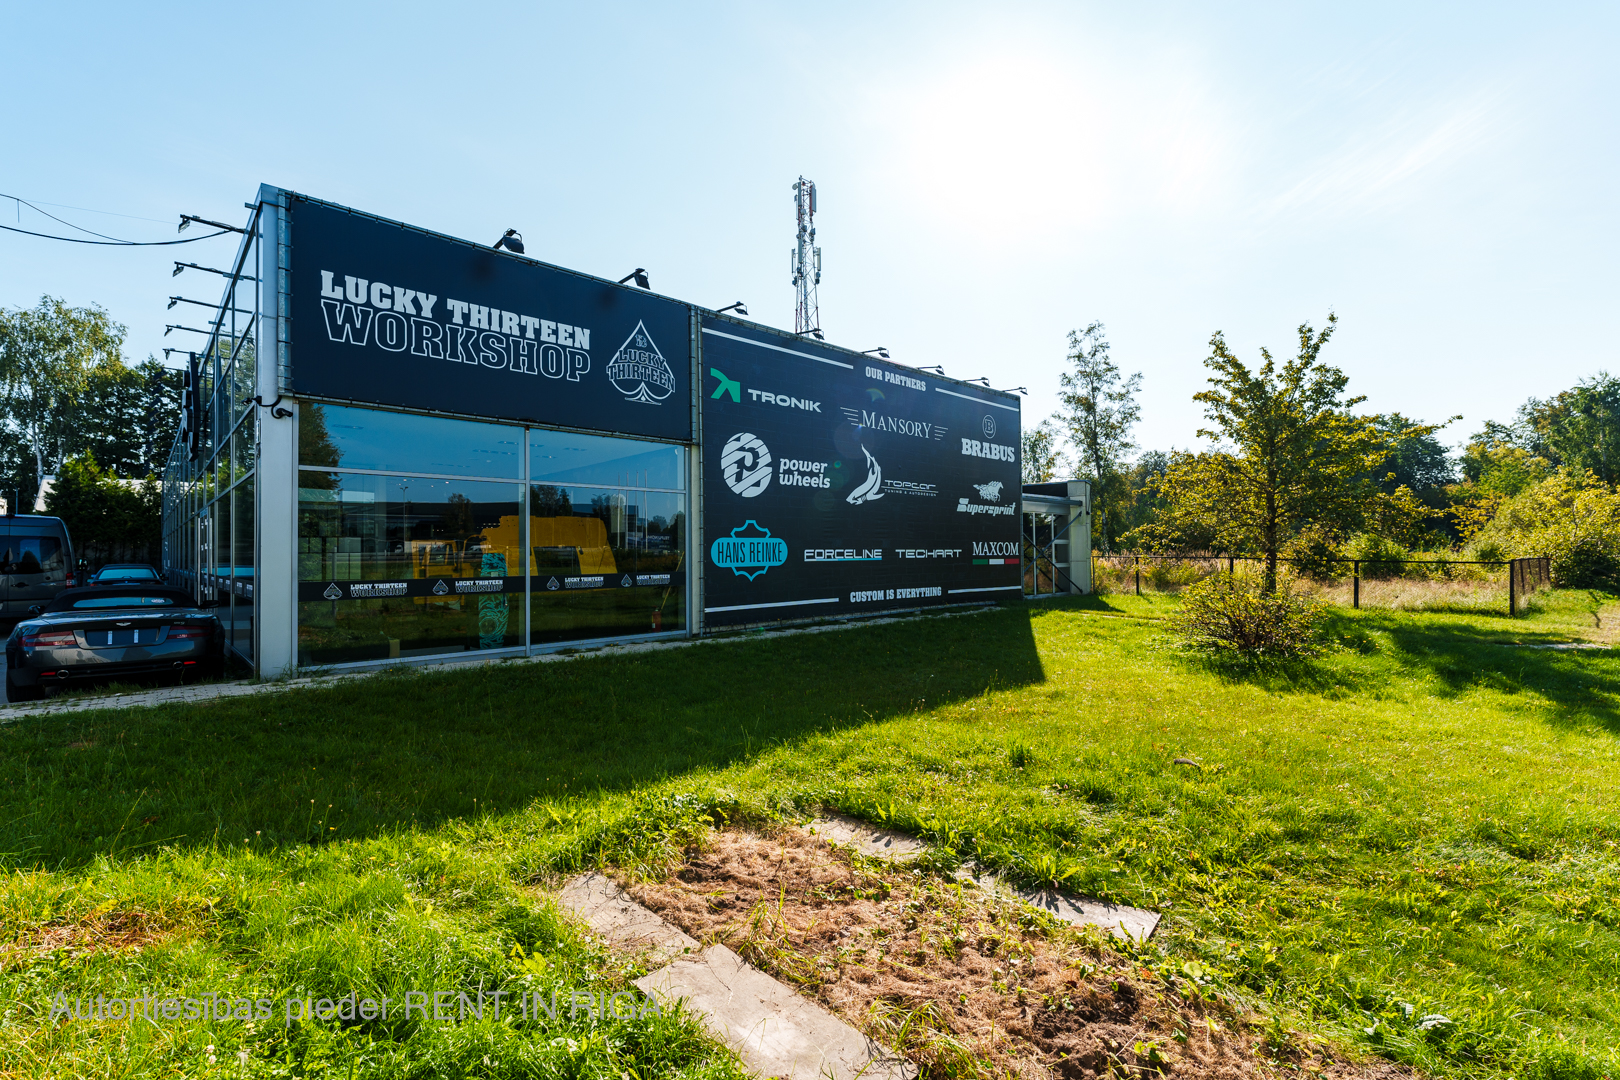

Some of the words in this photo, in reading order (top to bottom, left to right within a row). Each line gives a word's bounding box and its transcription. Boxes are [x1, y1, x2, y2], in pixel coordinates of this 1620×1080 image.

[320, 270, 437, 318] LUCKY
[446, 298, 591, 350] THIRTEEN
[320, 300, 591, 382] WORKSHOP
[618, 349, 667, 370] LUCKY
[606, 363, 676, 393] THIRTEEN
[865, 366, 883, 381] OUR
[885, 371, 927, 392] PARTNERS
[747, 388, 822, 413] TRONIK
[861, 410, 932, 439] MANSORY
[961, 438, 1016, 463] BRABUS
[779, 458, 828, 473] power
[779, 472, 831, 488] wheels
[957, 498, 1017, 517] Supersprint
[717, 542, 746, 563] HANS
[749, 542, 782, 563] REINKE
[804, 549, 882, 560] FORCELINE
[895, 549, 962, 558] TECHART
[972, 541, 1020, 556] MAXCOM
[350, 588, 408, 598] WORKSHOP
[850, 590, 884, 603] CUSTOM
[886, 588, 895, 600] IS
[896, 586, 942, 599] EVERYTHING
